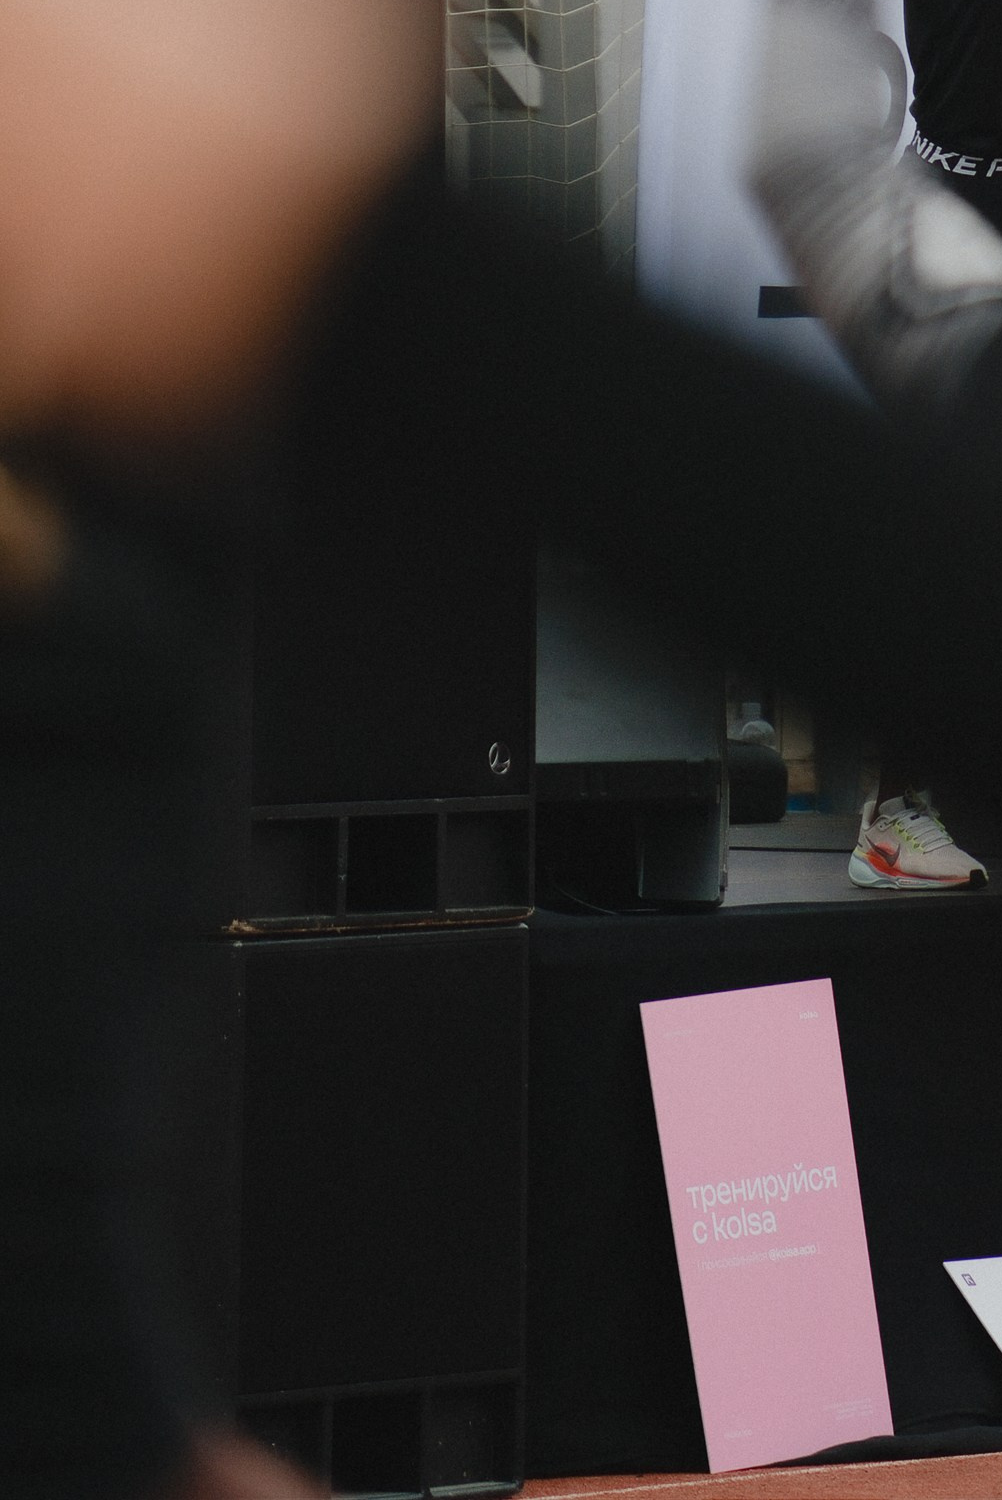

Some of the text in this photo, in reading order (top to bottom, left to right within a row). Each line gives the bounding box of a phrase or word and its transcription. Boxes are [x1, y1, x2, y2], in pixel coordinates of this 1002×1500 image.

[911, 130, 984, 176] NIKE
[686, 1162, 838, 1213] тренируйся
[692, 1207, 777, 1244] с kolsa
